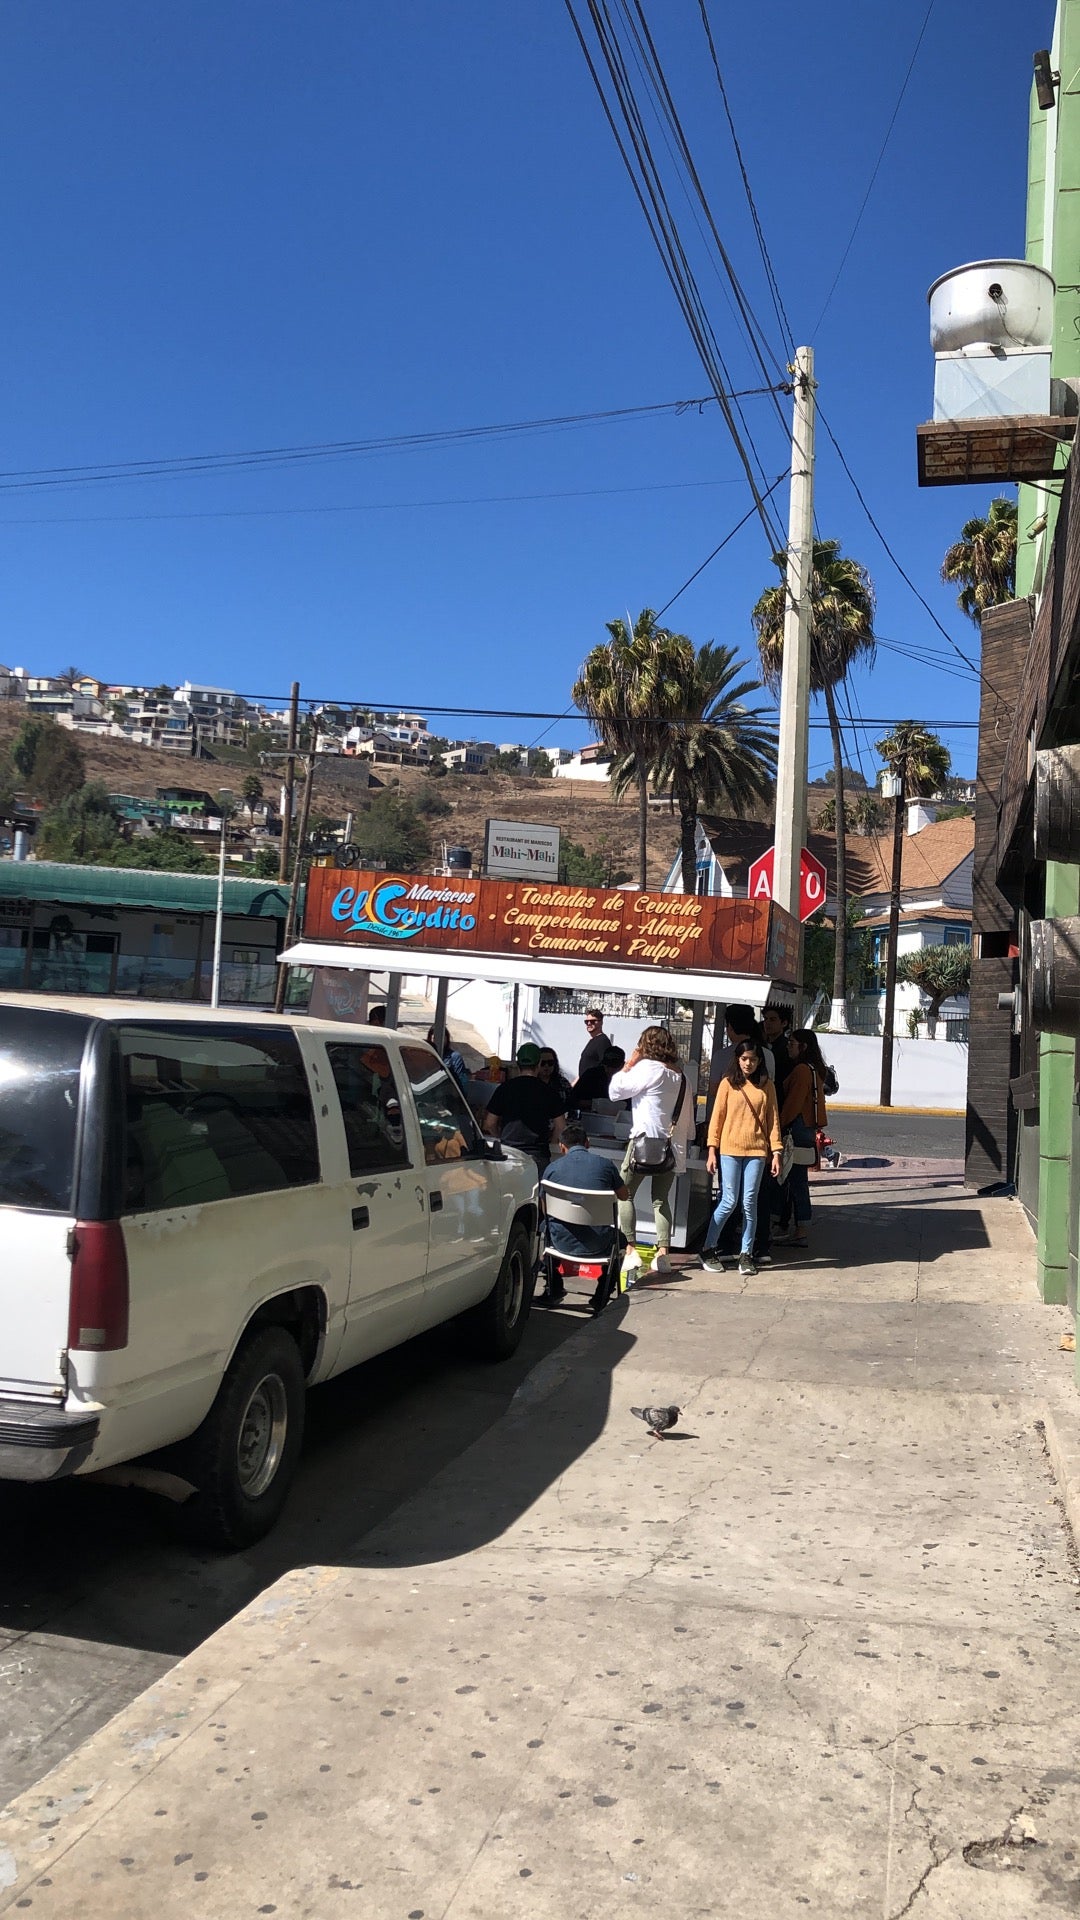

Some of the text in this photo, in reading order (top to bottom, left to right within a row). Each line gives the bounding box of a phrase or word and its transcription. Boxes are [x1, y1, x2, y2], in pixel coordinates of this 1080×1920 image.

[496, 836, 523, 844] RESTAURANT
[406, 884, 476, 904] Mariscos
[753, 869, 822, 899] AO
[331, 884, 476, 931] El Gordito
[521, 887, 703, 918] Tostadas de Ceviche
[366, 922, 388, 934] Desde
[503, 907, 704, 944] Campechanas Almeja
[528, 931, 682, 964] Camarón Pulpo
